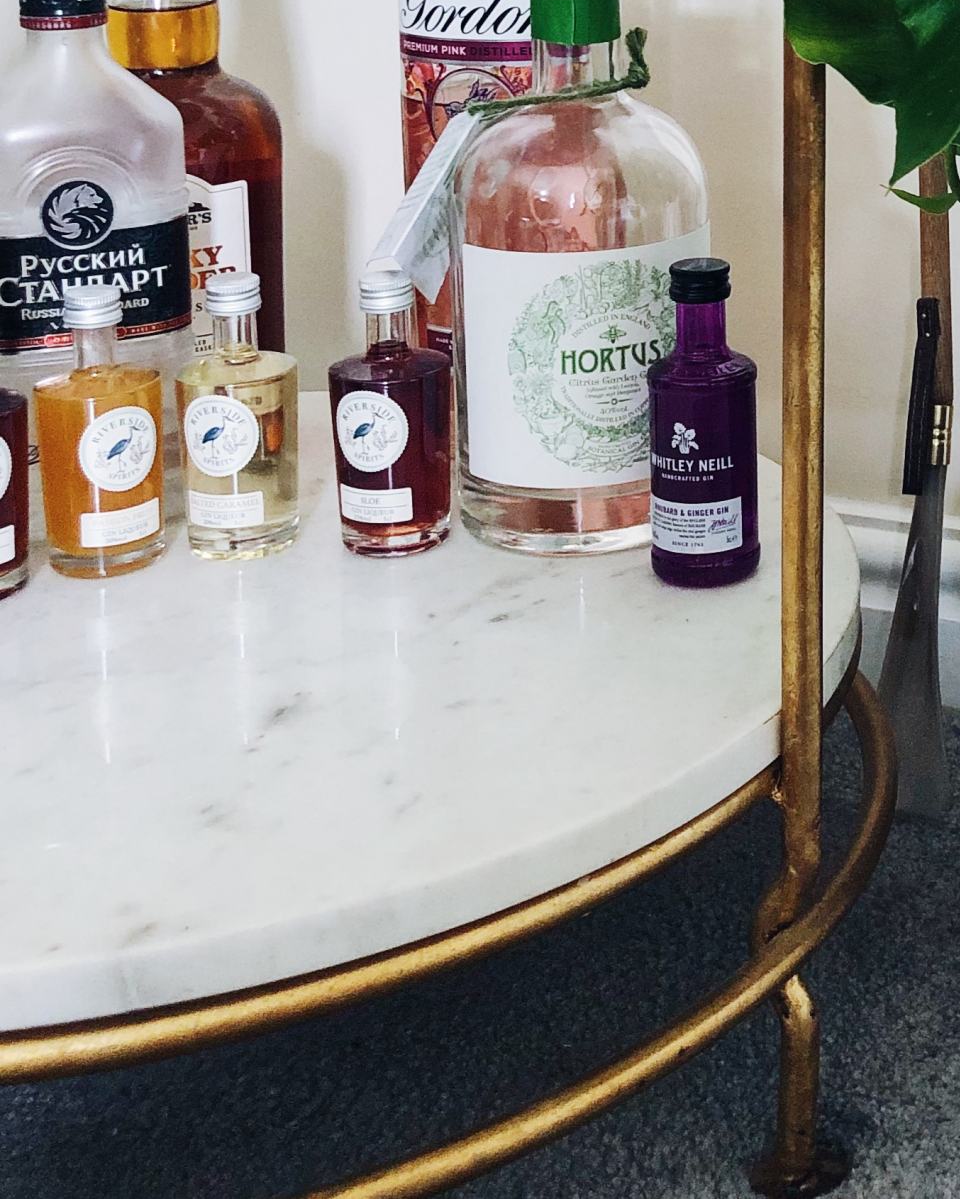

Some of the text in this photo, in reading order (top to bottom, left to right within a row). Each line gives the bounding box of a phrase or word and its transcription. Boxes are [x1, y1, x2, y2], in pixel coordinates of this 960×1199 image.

[403, 40, 532, 57] PREMIUM PINK DISTILLE
[560, 339, 662, 376] HORTUS
[568, 378, 600, 387] Citrus
[602, 373, 638, 385] Garden
[190, 405, 247, 426] RIVERSIDE
[341, 402, 396, 421] RIVERSIDE
[92, 416, 149, 444] RIVERSIDE
[651, 452, 734, 473] WHITLEY NEILL
[687, 508, 715, 517] GINGER
[716, 506, 729, 515] GIN
